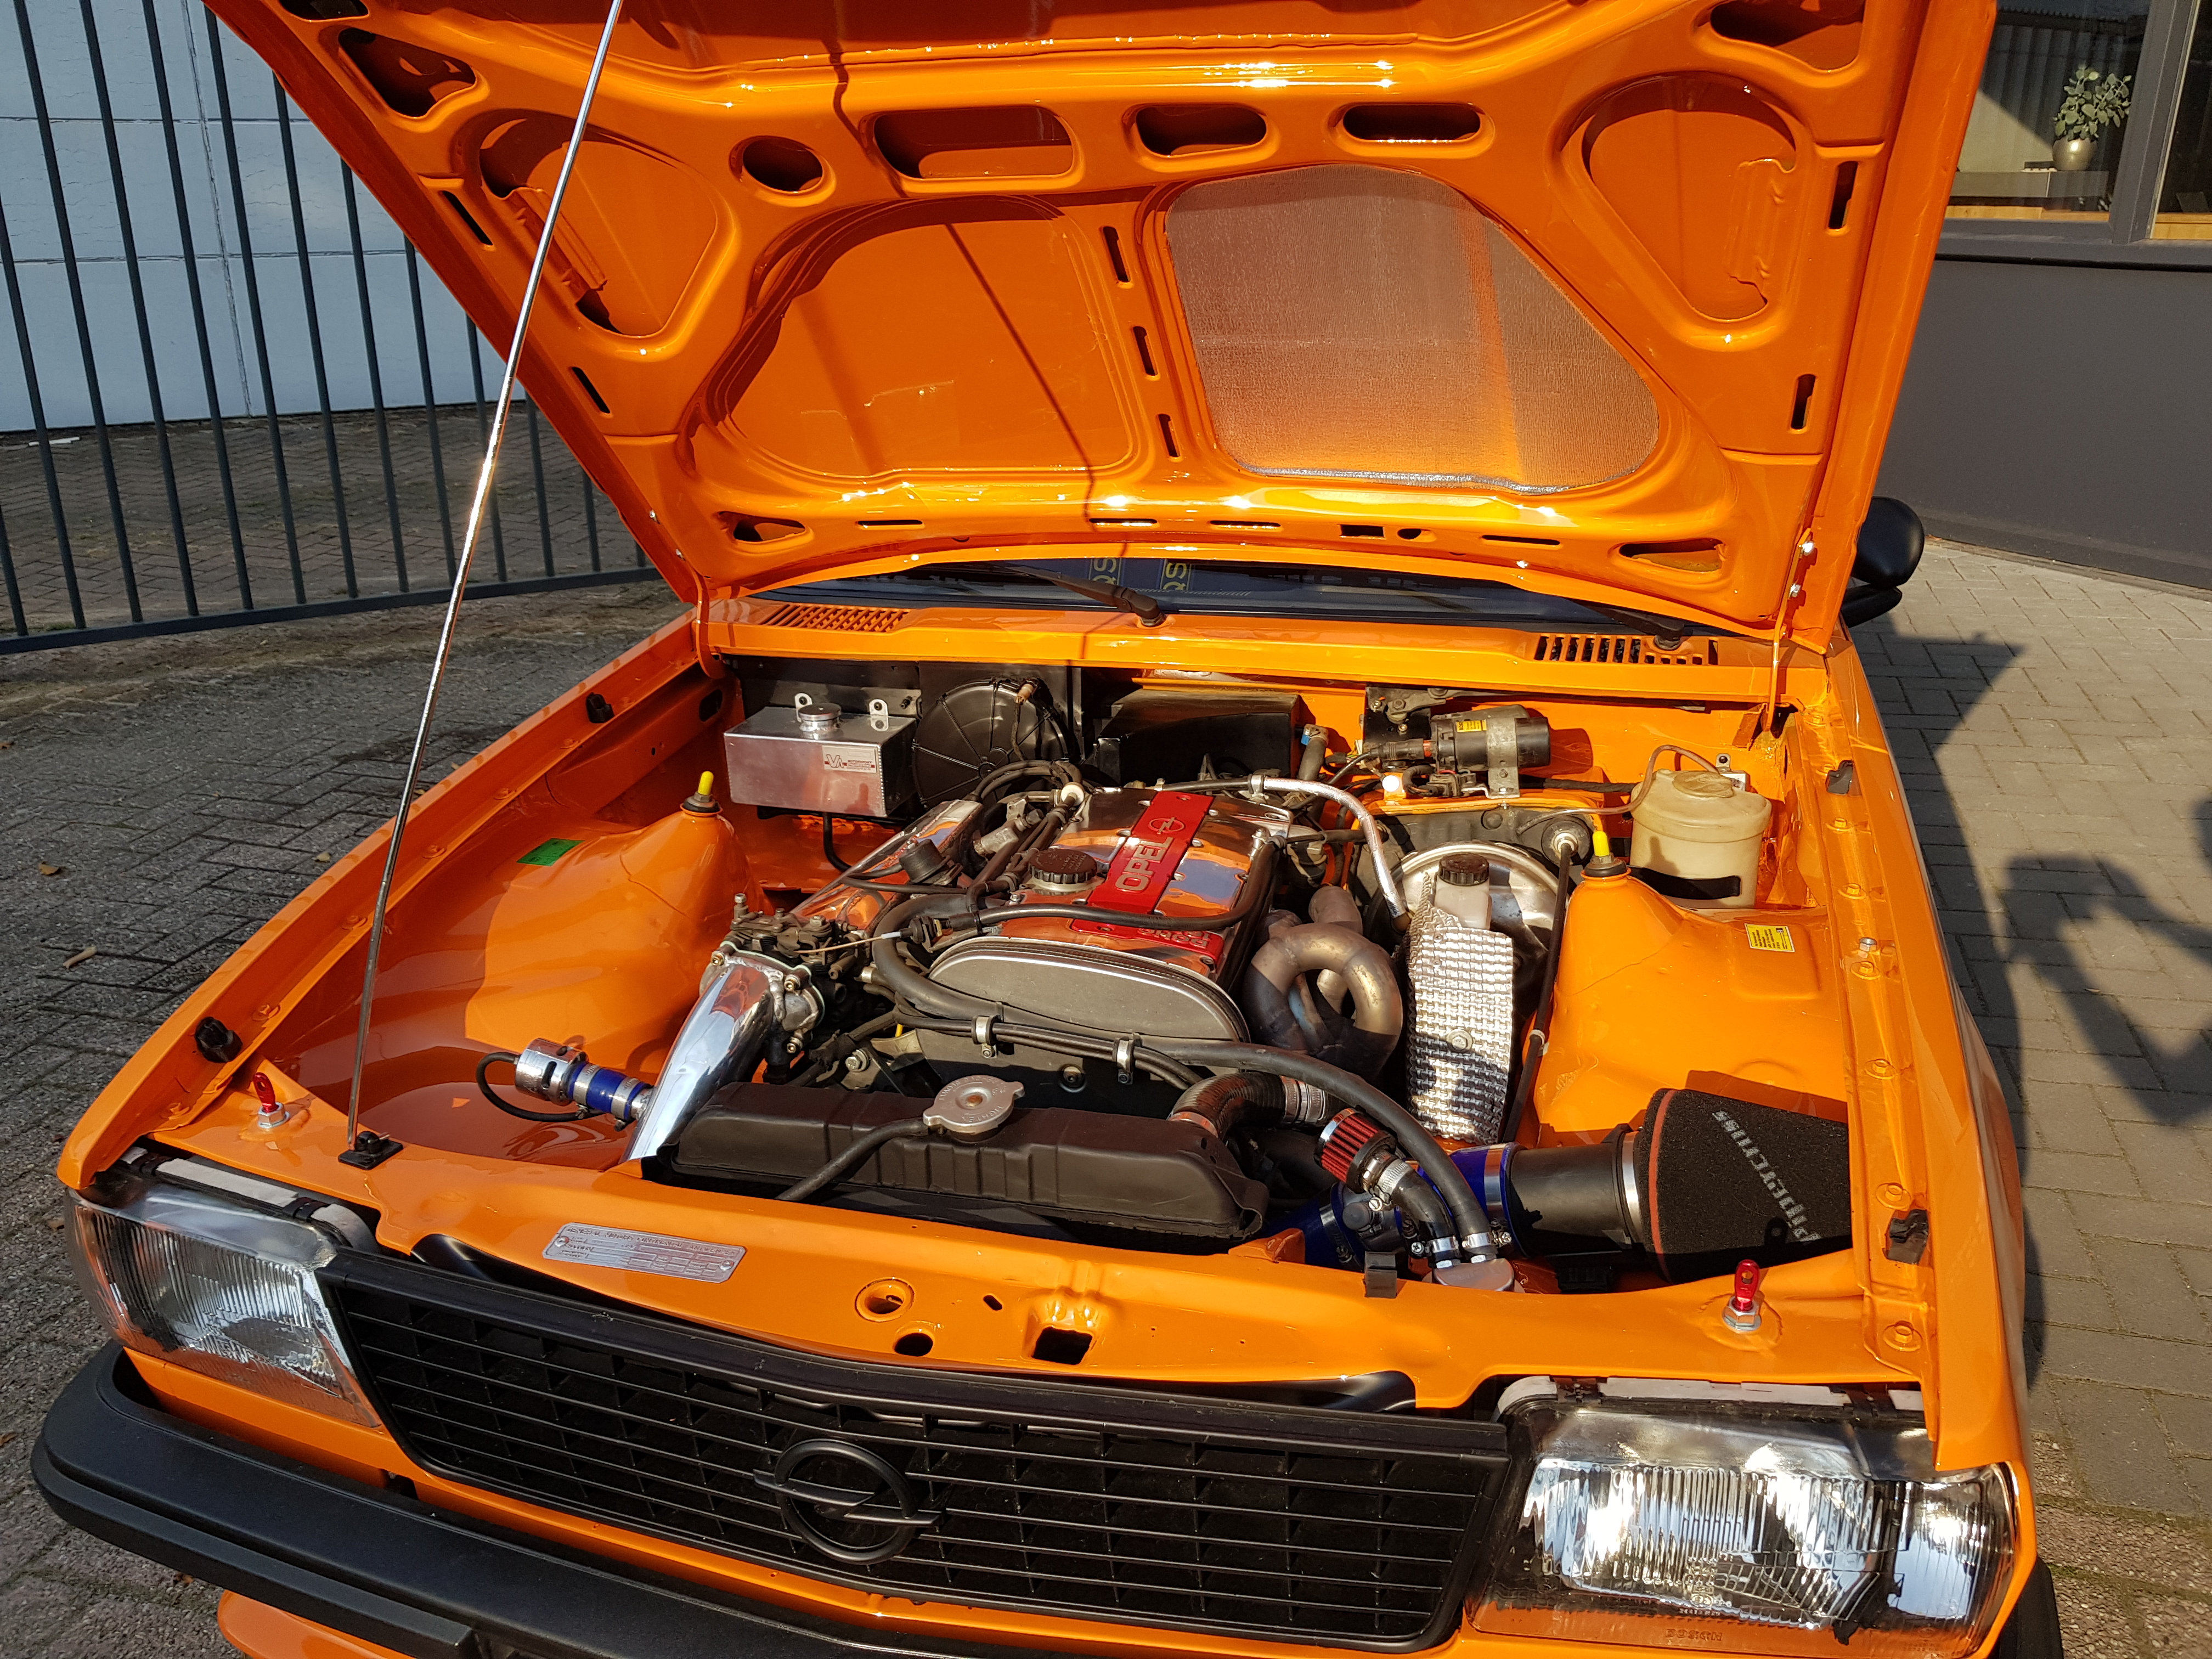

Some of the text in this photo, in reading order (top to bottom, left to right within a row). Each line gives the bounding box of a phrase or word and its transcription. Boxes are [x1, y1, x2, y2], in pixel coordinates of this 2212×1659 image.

[1115, 837, 1174, 892] OPEL
[1137, 928, 1208, 949] DOHC
[1664, 1628, 1723, 1641] BOSCH
